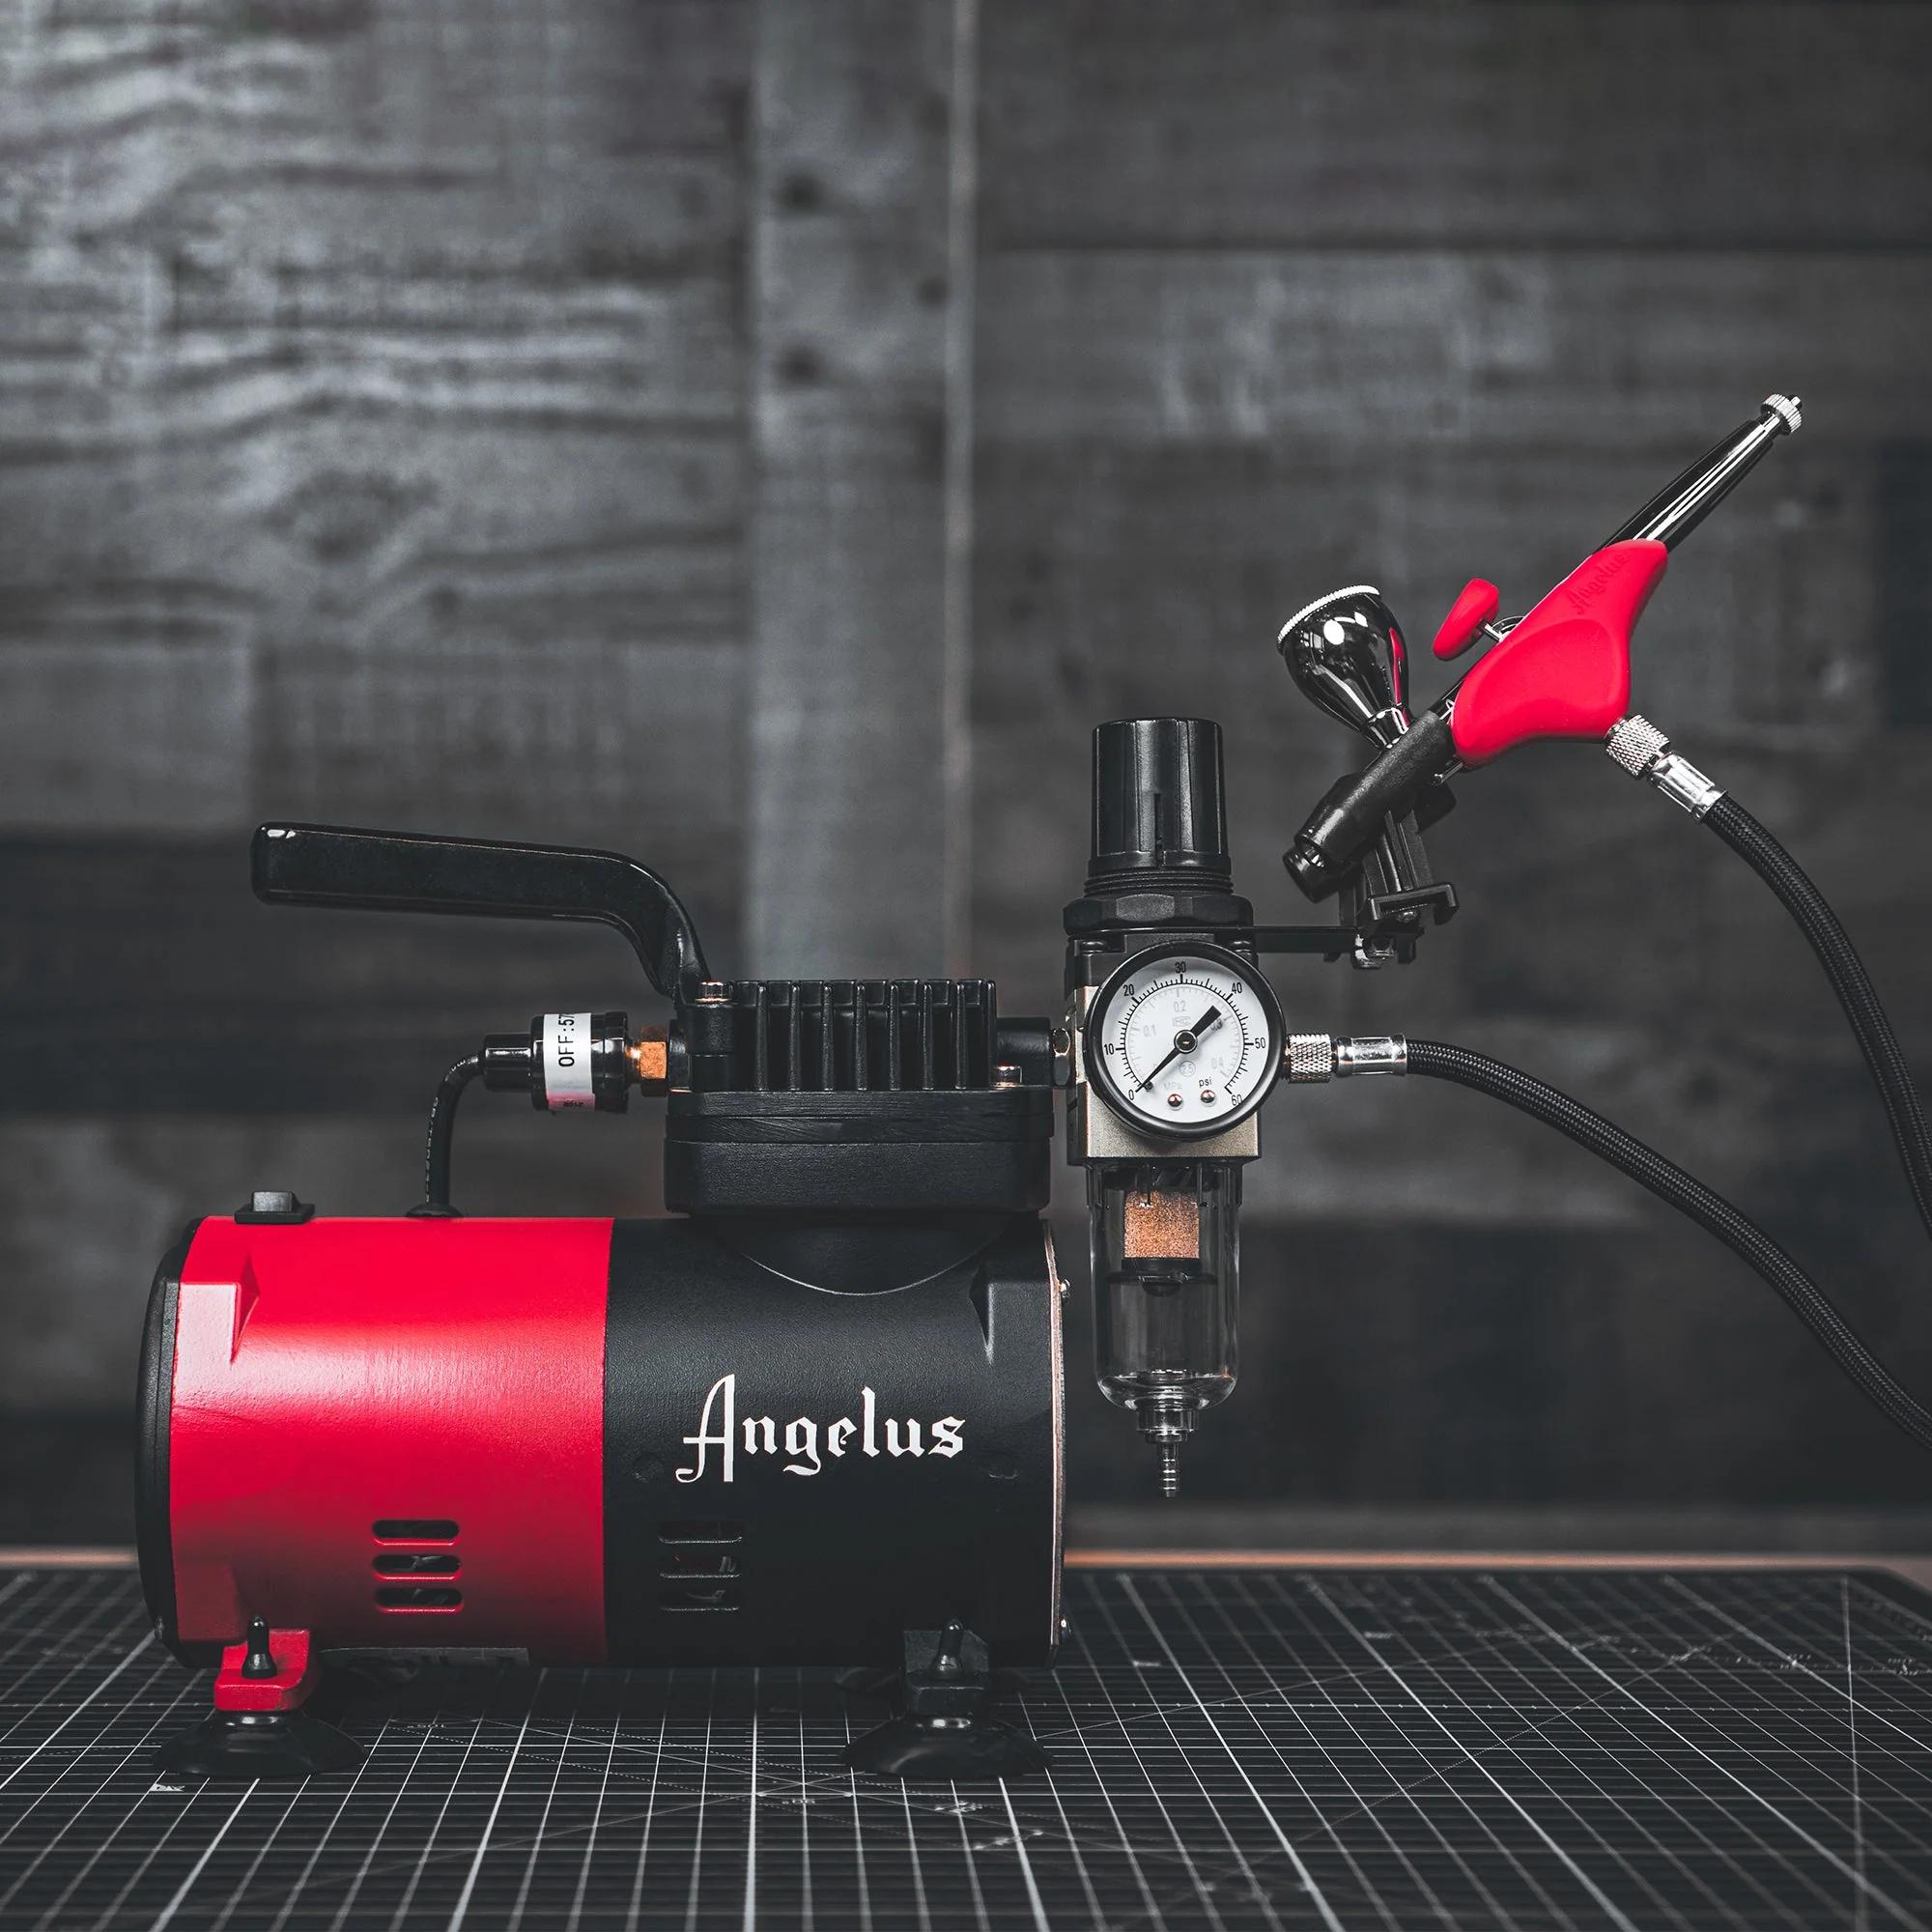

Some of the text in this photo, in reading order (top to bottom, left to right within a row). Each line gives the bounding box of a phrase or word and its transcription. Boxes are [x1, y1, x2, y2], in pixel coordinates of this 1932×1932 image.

[1566, 554, 1631, 614] Angelus
[1175, 961, 1187, 974] 30
[1122, 983, 1135, 997] 20
[1231, 981, 1243, 995] 40
[1103, 1042, 1115, 1056] 10
[1254, 1037, 1266, 1049] 50
[1198, 1078, 1212, 1089] psi
[1127, 1089, 1135, 1101] 0
[1231, 1094, 1243, 1107] 60
[675, 1374, 966, 1483] Angelus
